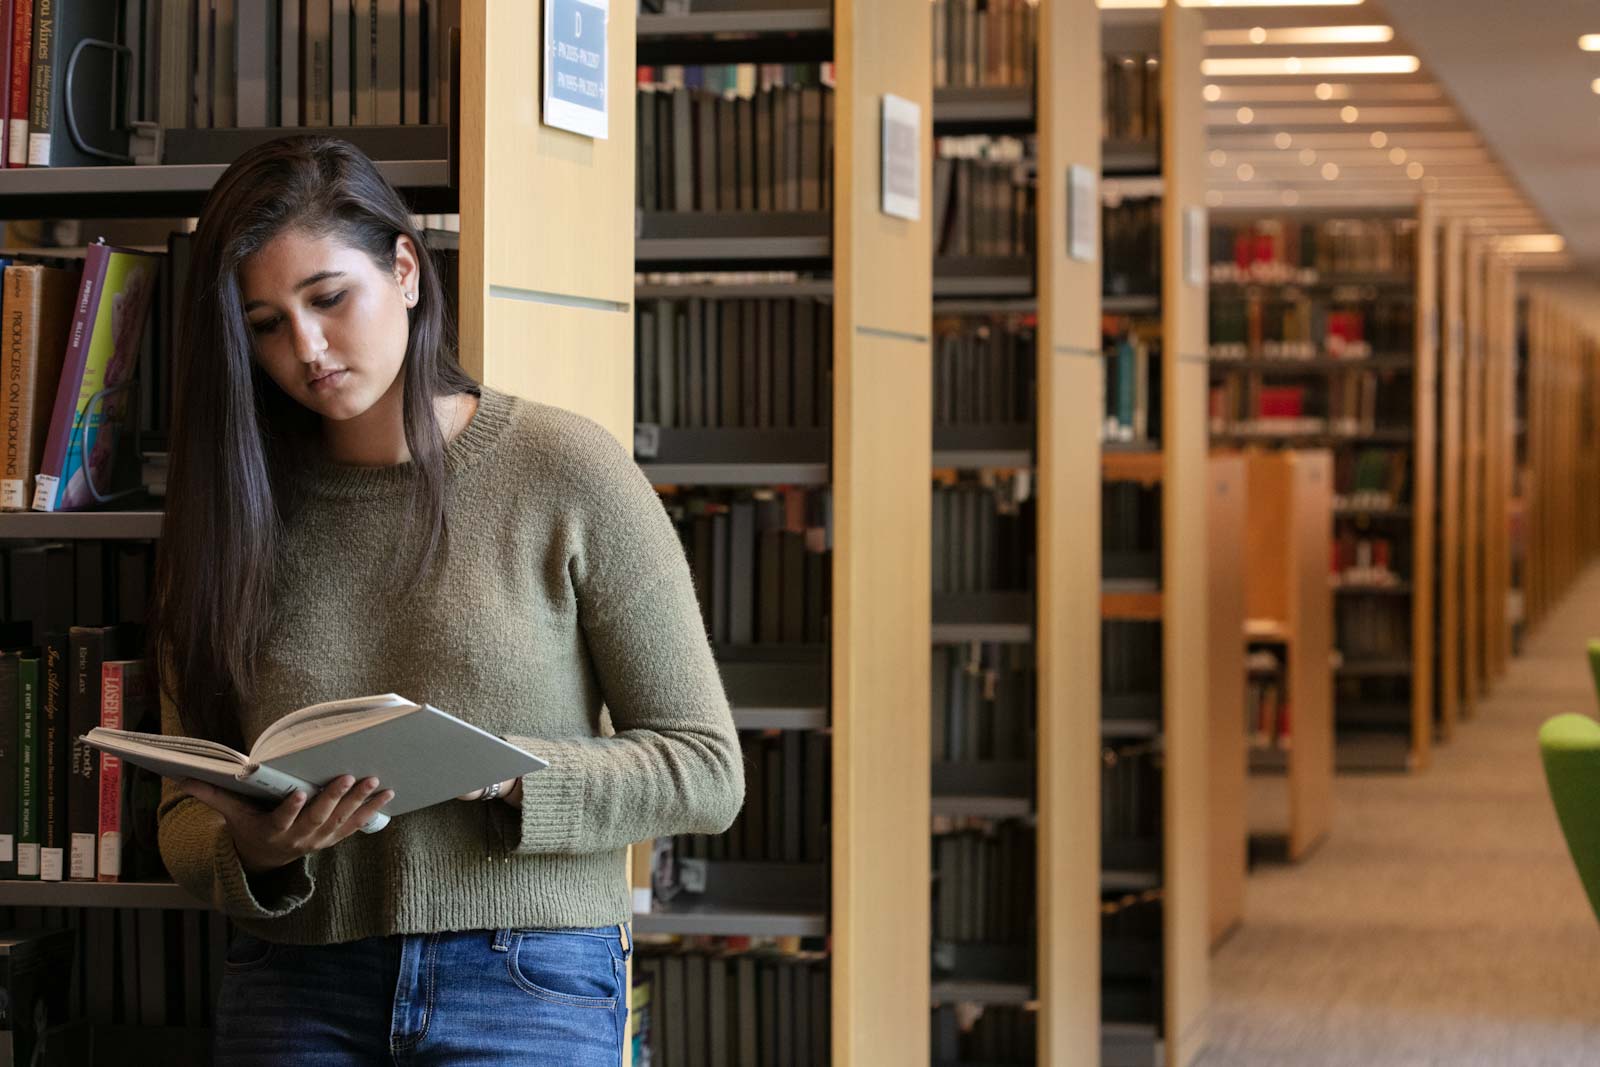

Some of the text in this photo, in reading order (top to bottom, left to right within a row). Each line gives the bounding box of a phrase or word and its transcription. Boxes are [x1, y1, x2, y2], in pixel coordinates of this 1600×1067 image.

[38, 19, 53, 60] Mines
[11, 310, 23, 380] PRODUCERS
[10, 383, 20, 403] ON
[6, 405, 20, 476] PRODUCING
[79, 646, 88, 695] Eric Lax
[104, 677, 120, 714] LOSER
[24, 712, 32, 720] IN
[24, 721, 32, 738] SPACE
[72, 736, 83, 775] Allen
[80, 744, 93, 779] oody
